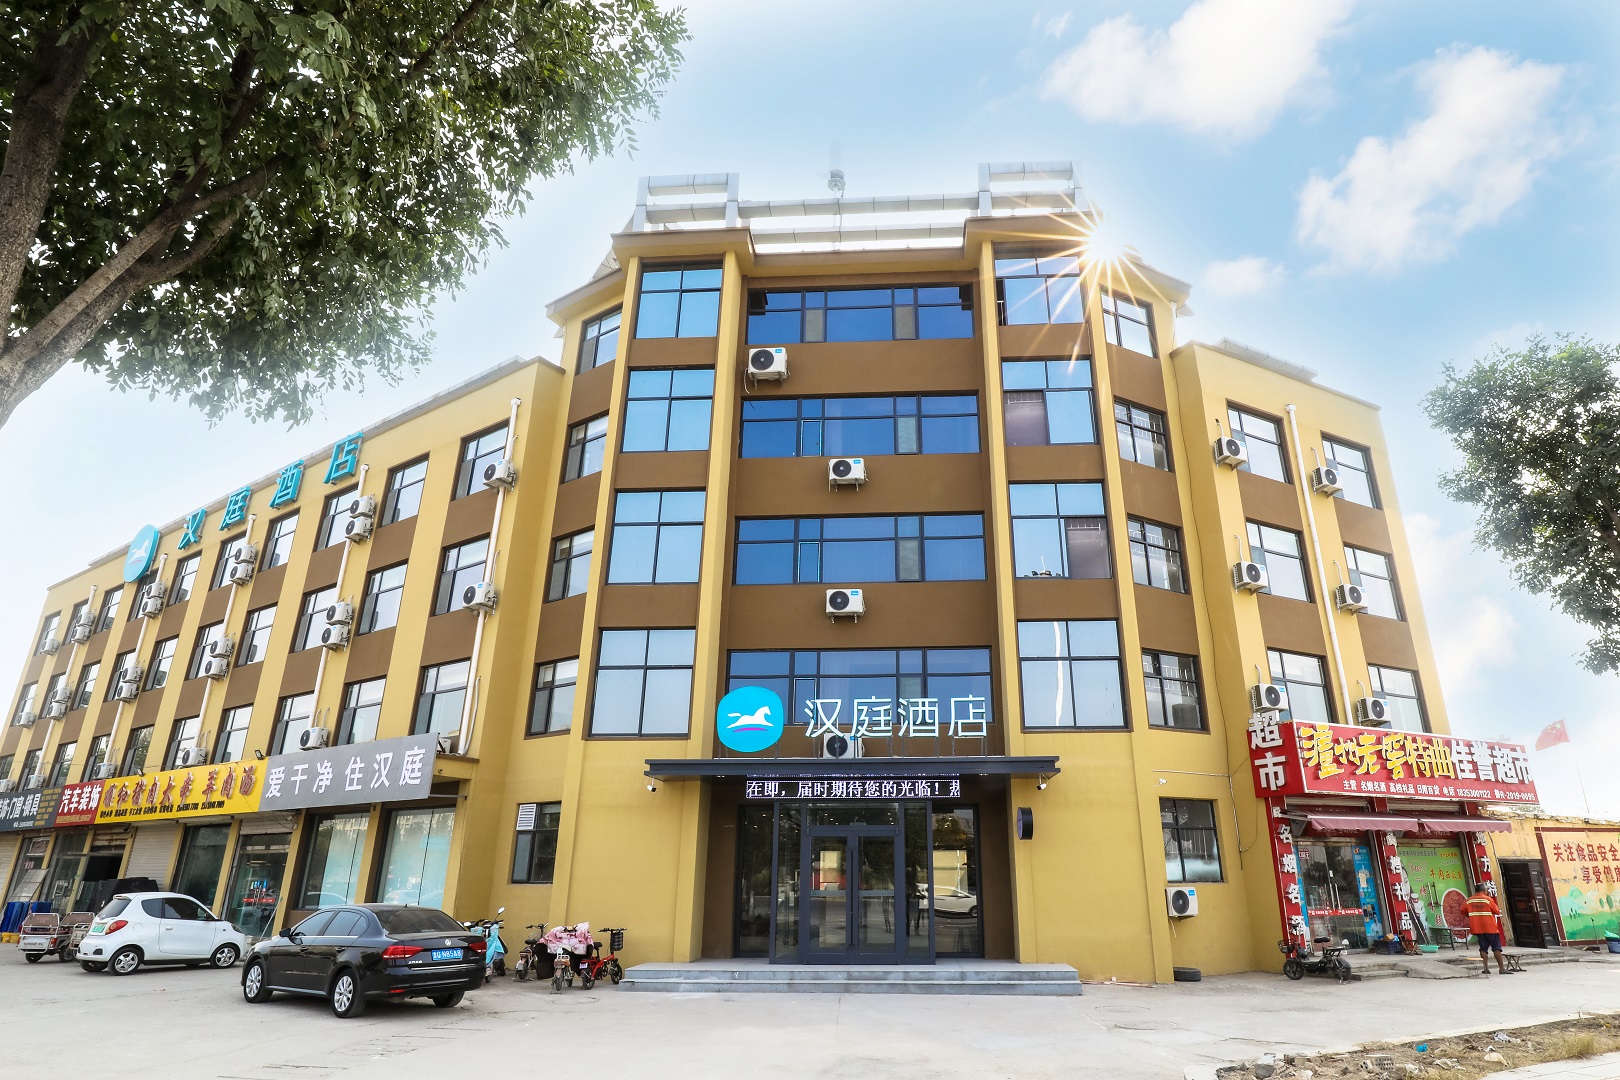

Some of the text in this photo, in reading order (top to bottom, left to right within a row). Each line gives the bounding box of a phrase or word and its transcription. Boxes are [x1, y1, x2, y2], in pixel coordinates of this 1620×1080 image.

[177, 431, 364, 550] 汉庭酒店
[804, 694, 987, 738] 汉庭酒店
[266, 745, 426, 799] 爱干净 住汉庭
[1248, 709, 1286, 791] 超市
[59, 784, 101, 813] 汽车装饰
[1343, 780, 1357, 790] 主营
[1360, 780, 1387, 792] 名烟名酒
[1389, 782, 1415, 794] 高档礼品
[1417, 784, 1440, 795] 日用百货
[1442, 786, 1456, 796] 电话
[1278, 824, 1306, 935] 名烟名酒
[1553, 843, 1620, 862] 关注食品安全
[1386, 831, 1413, 930] 高档礼品
